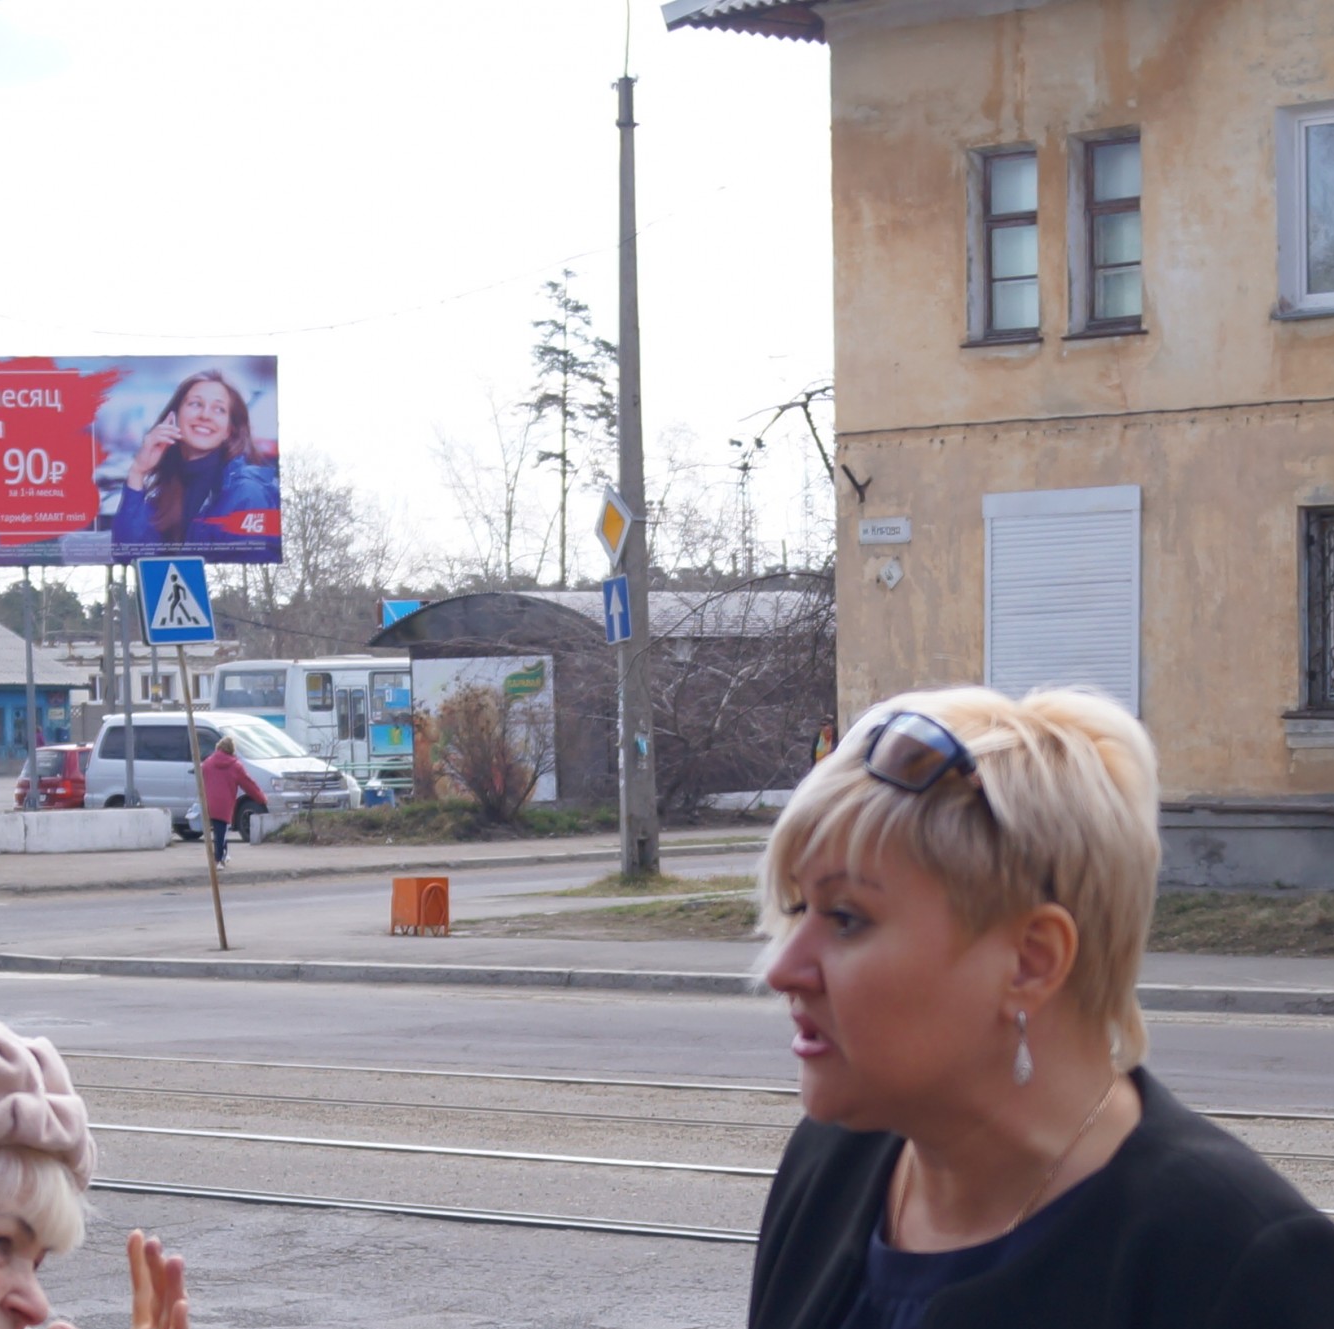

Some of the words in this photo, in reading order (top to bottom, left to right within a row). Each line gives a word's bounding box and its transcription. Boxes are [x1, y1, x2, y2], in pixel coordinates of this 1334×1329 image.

[20, 487, 34, 497] 1-й
[36, 488, 65, 498] месяц
[0, 512, 32, 524] тарифе
[34, 512, 65, 522] SMART
[66, 512, 86, 521] mini
[240, 513, 265, 533] 4G
